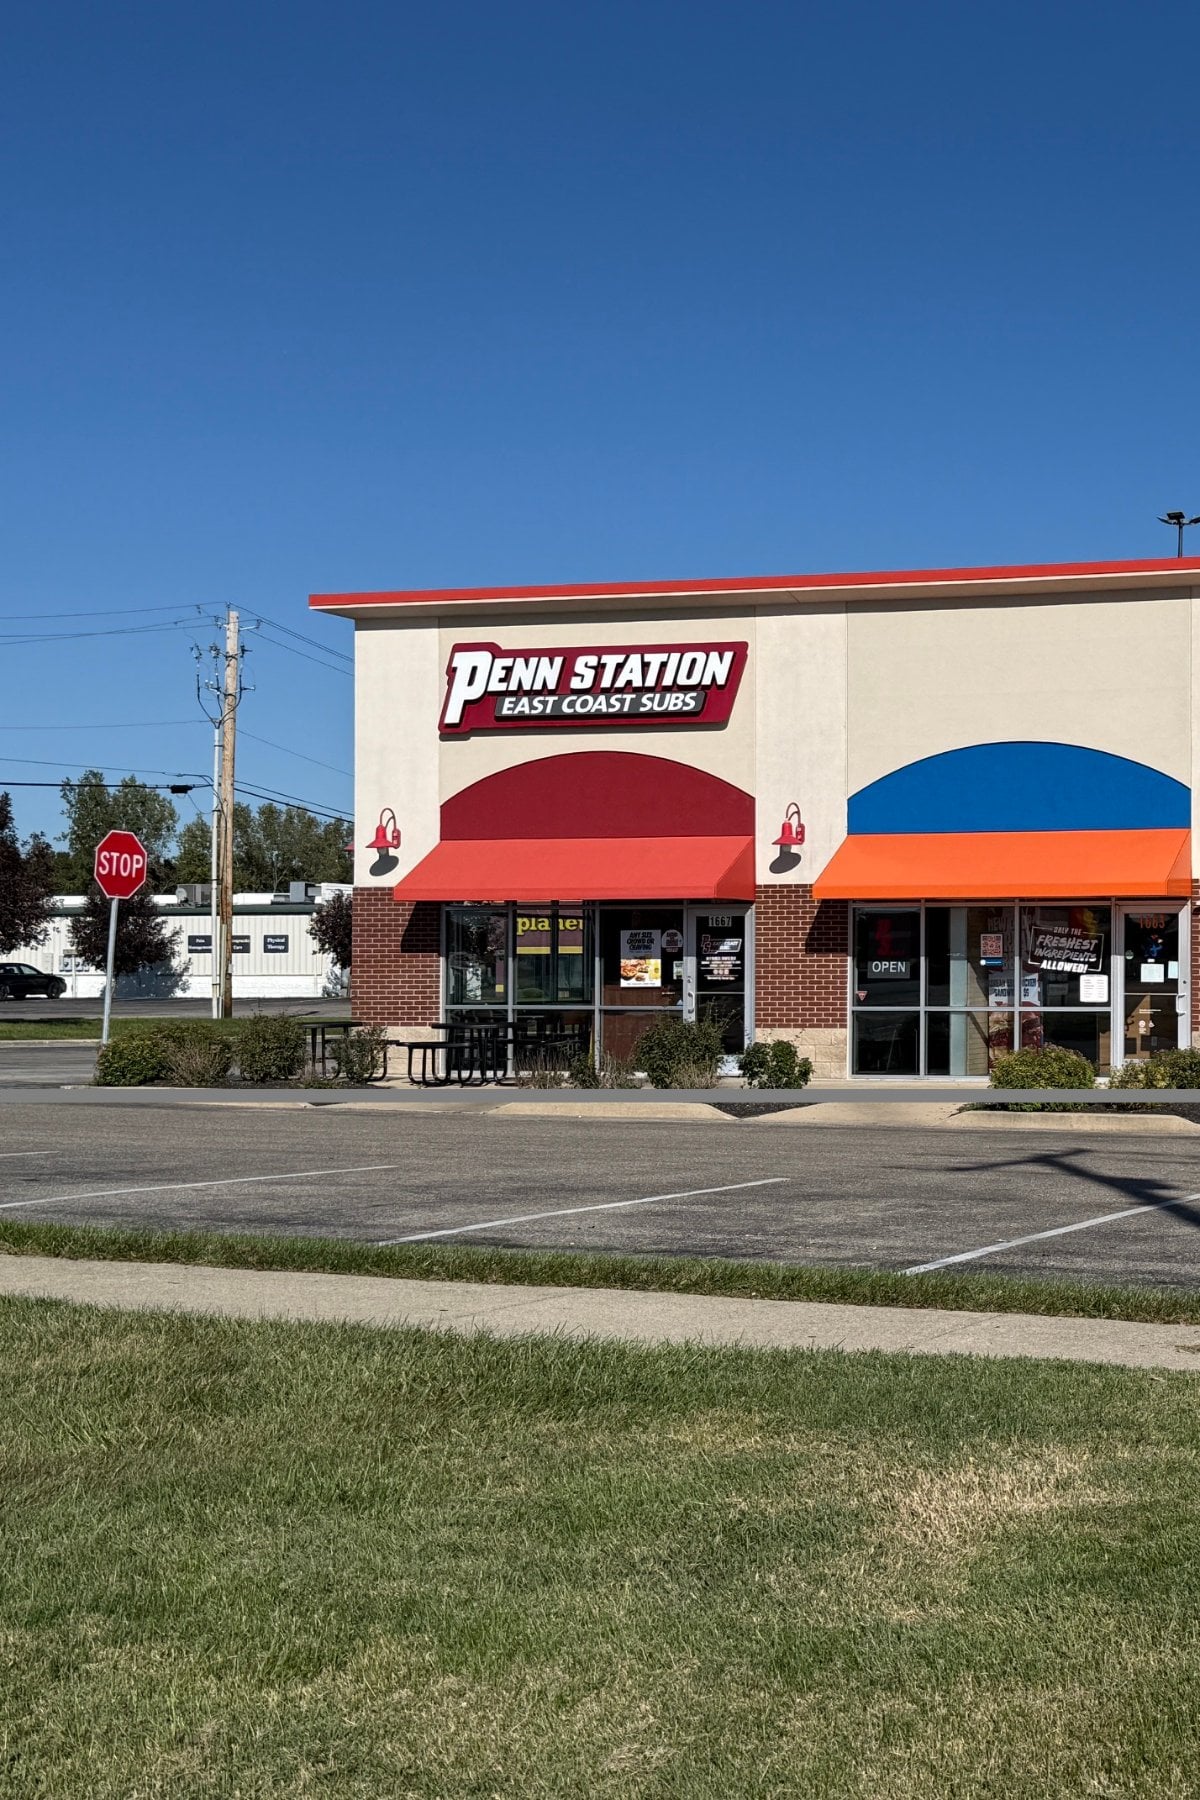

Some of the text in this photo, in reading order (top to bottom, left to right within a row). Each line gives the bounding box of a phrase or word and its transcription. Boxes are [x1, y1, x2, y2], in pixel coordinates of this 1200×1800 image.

[444, 650, 735, 724] PENN STATION
[502, 692, 698, 715] EAST COAST SUBS
[99, 851, 143, 878] STOP
[709, 916, 731, 926] 1667
[1053, 926, 1082, 935] ONLY THE
[1036, 934, 1098, 951] FRESHEST
[1034, 947, 1097, 962] INGREDIENTS
[872, 961, 906, 973] OPEN
[1040, 959, 1089, 974] ALLOWED!
